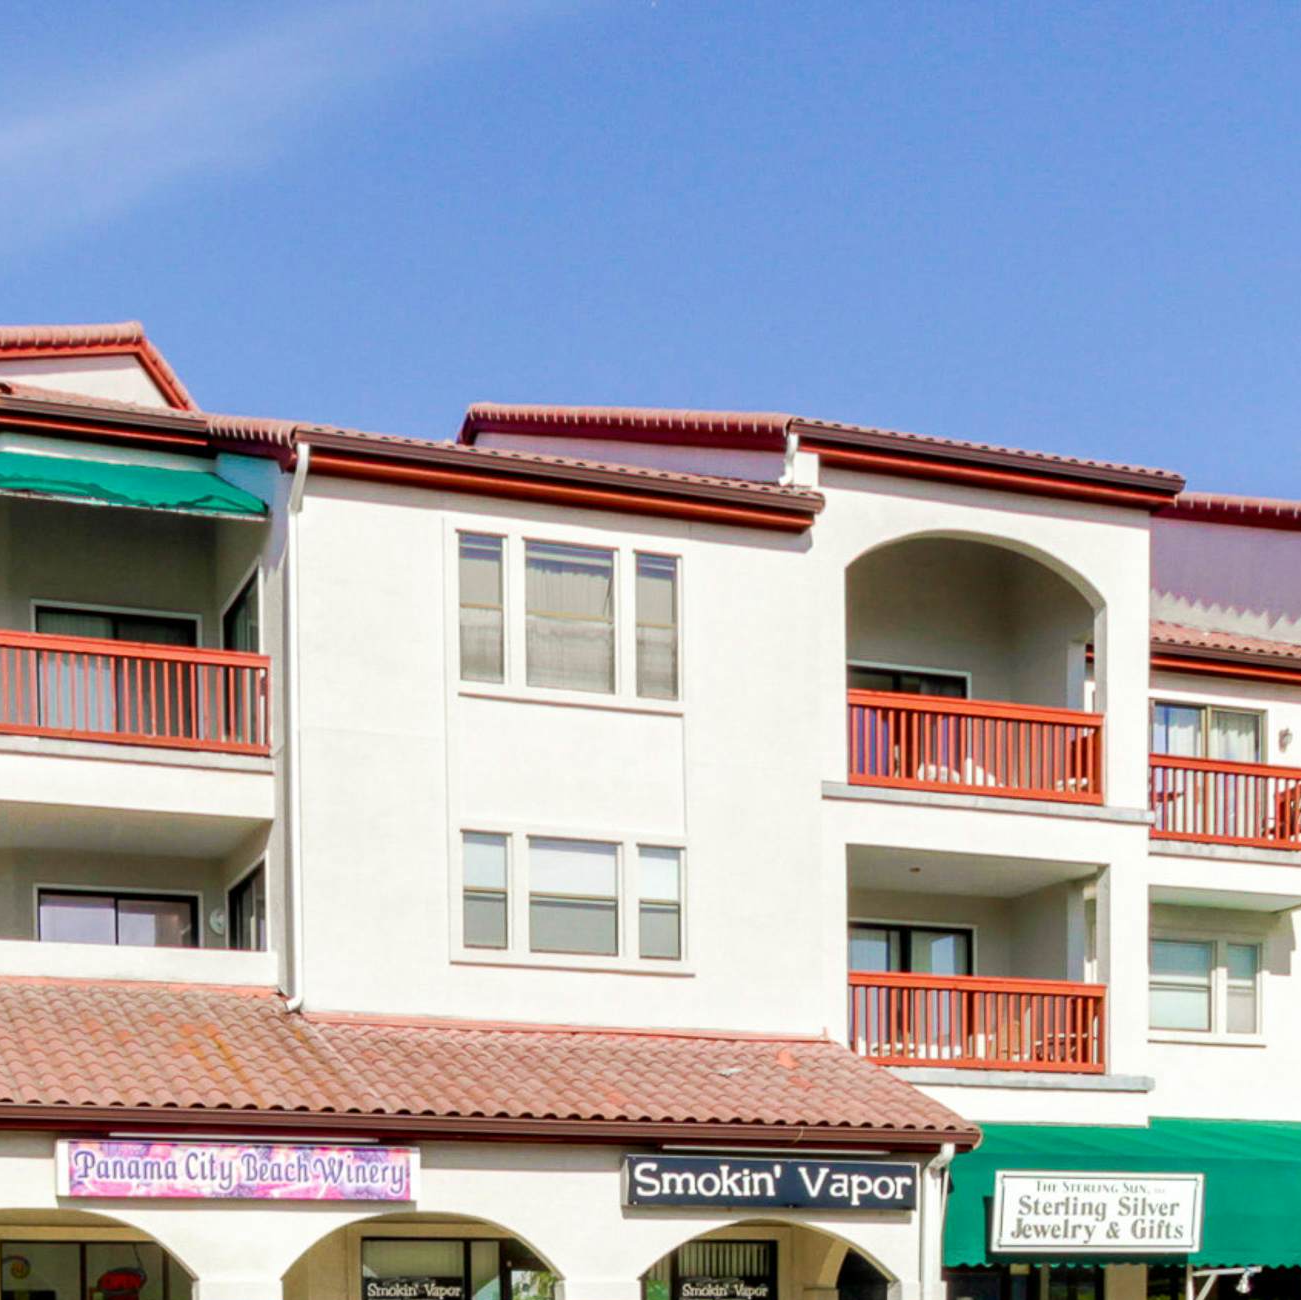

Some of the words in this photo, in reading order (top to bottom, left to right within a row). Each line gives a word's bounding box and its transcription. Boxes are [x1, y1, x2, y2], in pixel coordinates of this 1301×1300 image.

[74, 1150, 178, 1179] Panama
[185, 1152, 233, 1190] City
[241, 1153, 310, 1183] Beach
[312, 1155, 406, 1194] Winery
[633, 1162, 782, 1197] Smokin'
[798, 1166, 913, 1206] Vapor
[1036, 1180, 1056, 1193] THE
[1062, 1181, 1118, 1194] STERLING
[1018, 1195, 1107, 1222] Sterling
[1117, 1196, 1180, 1217] Silver
[1011, 1218, 1096, 1244] Jewelry
[1105, 1221, 1120, 1239] &
[1130, 1219, 1184, 1240] Gifts
[424, 1283, 462, 1300] Vapor
[733, 1283, 768, 1300] Vapor
